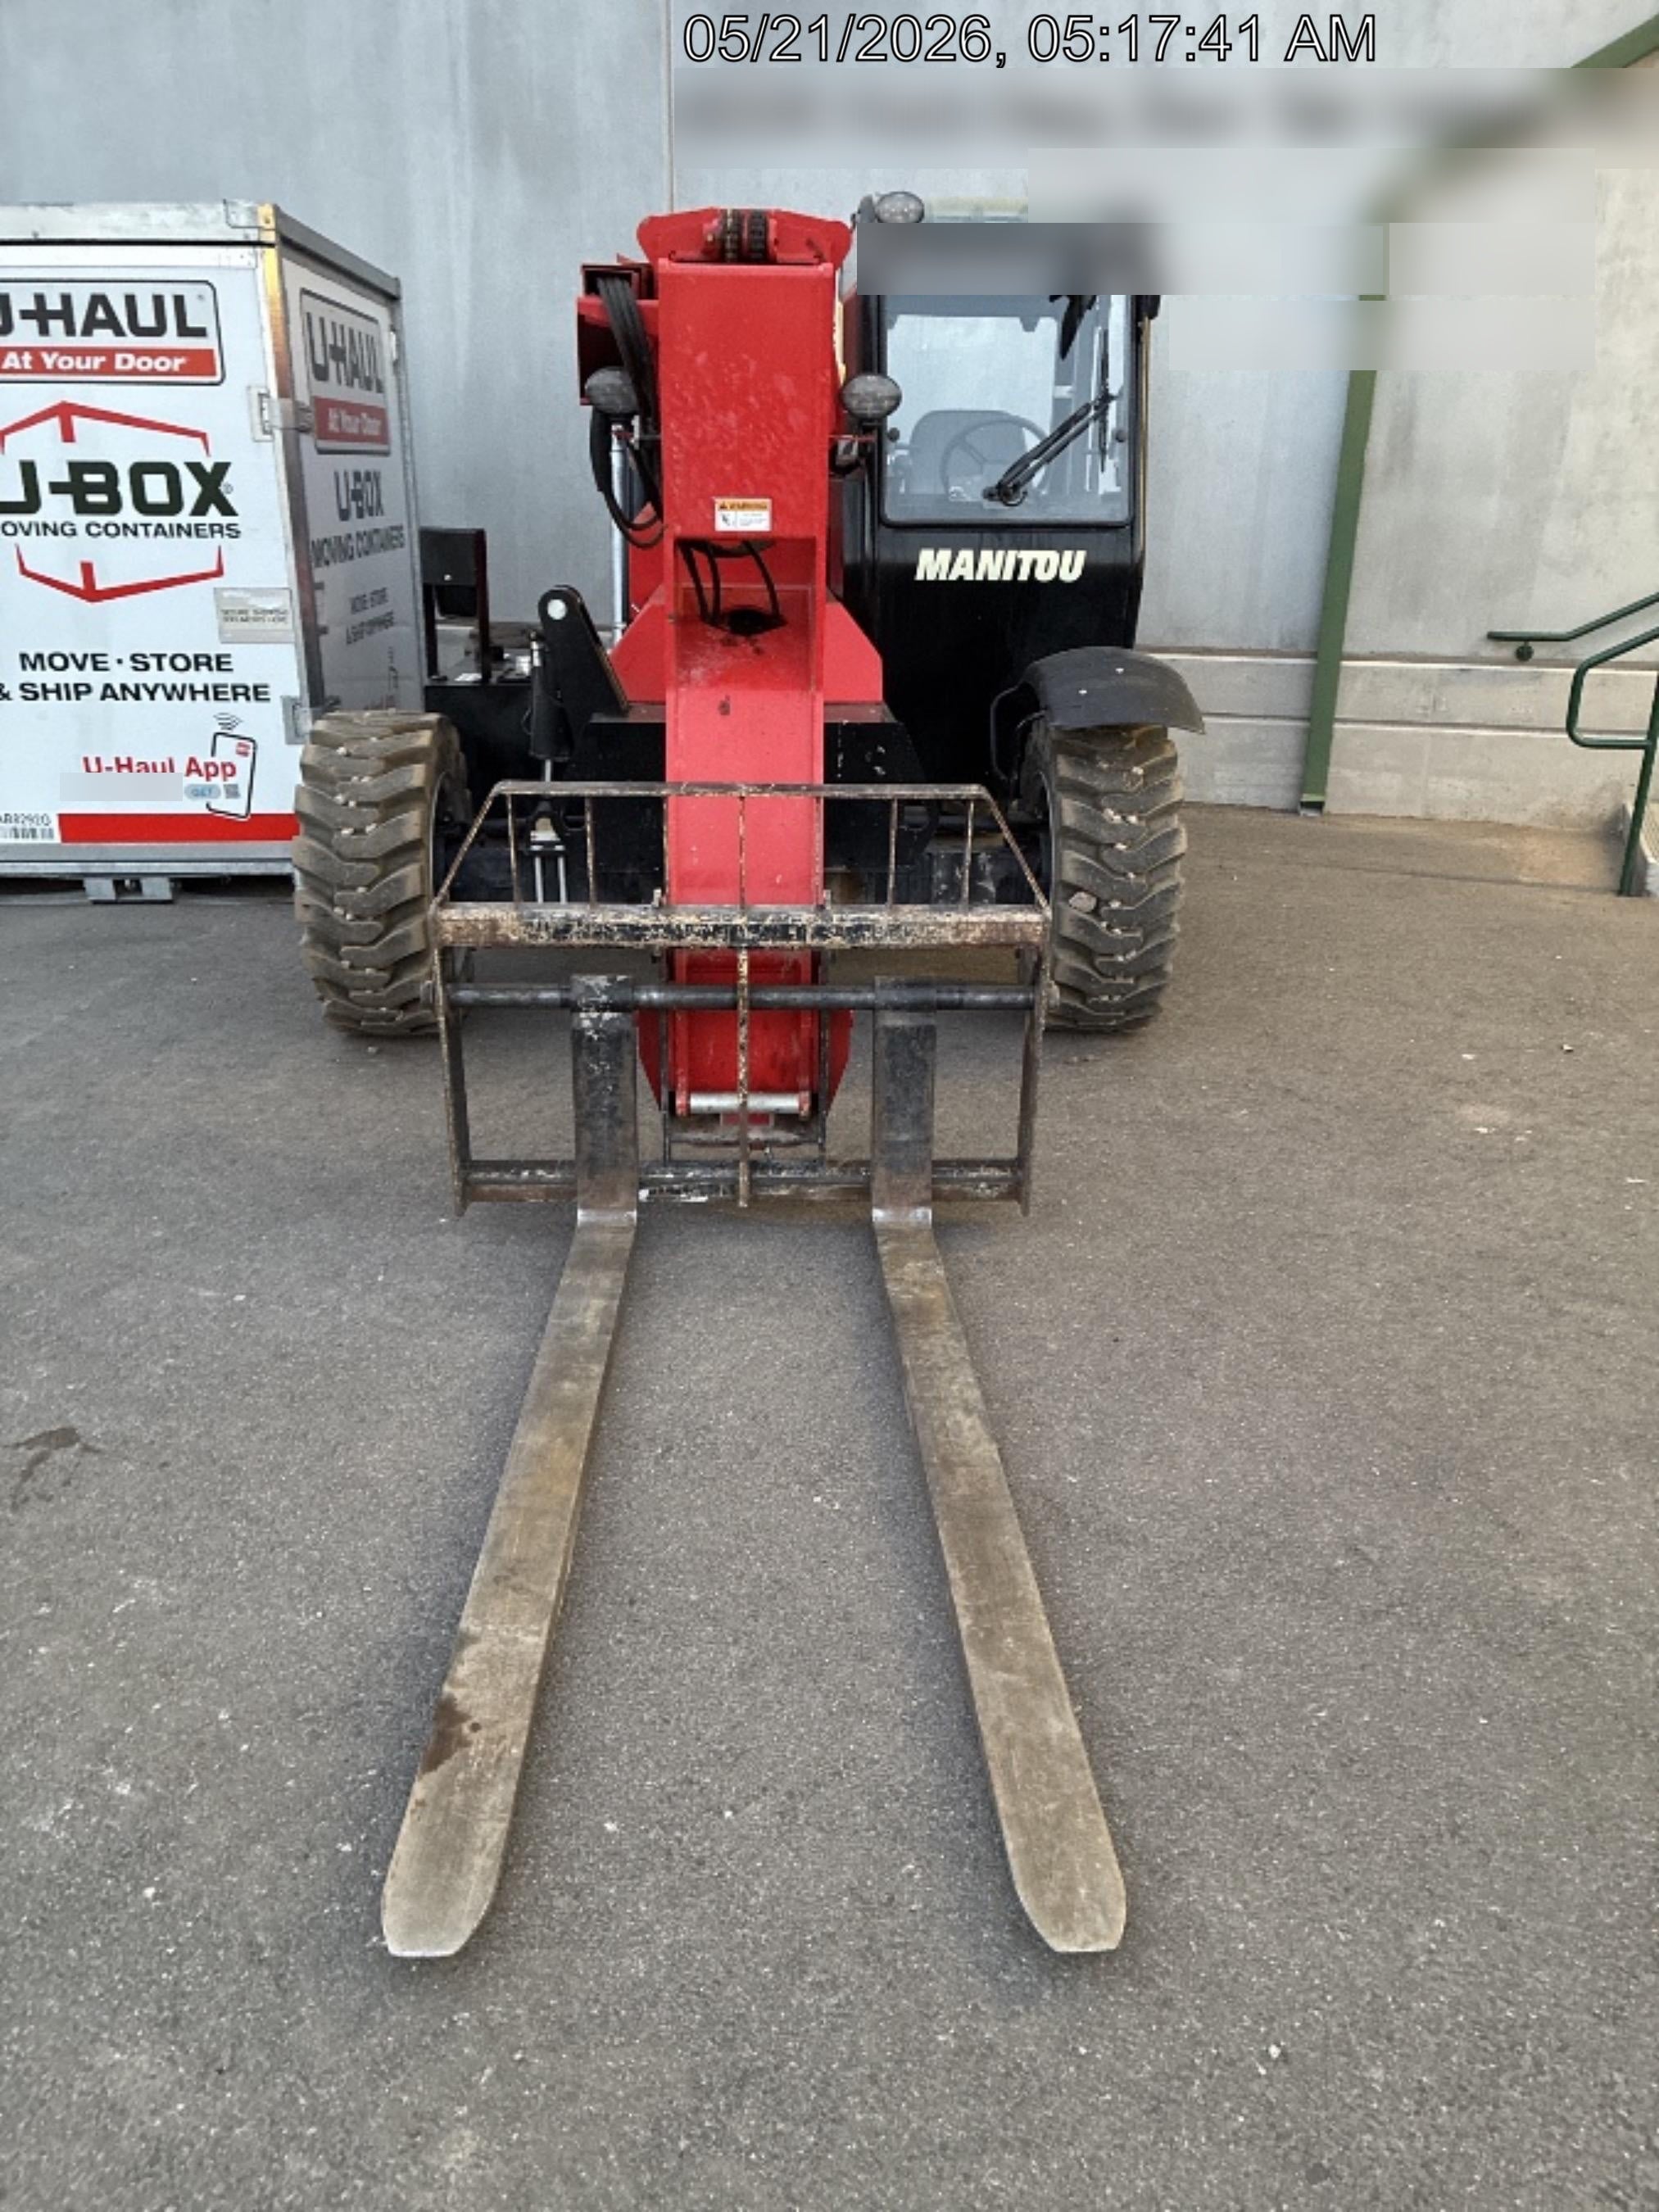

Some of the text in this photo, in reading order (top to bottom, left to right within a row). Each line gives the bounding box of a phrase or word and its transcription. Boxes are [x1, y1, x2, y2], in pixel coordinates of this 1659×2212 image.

[2, 351, 188, 372] At Your Door
[0, 520, 242, 538] OVING CONTAINERS
[914, 549, 1086, 582] MANITOU
[19, 653, 233, 673] MOVE STORE
[19, 683, 93, 701] SHIP
[100, 683, 270, 701] ANYWHERE
[83, 757, 236, 782] U-Haul App
